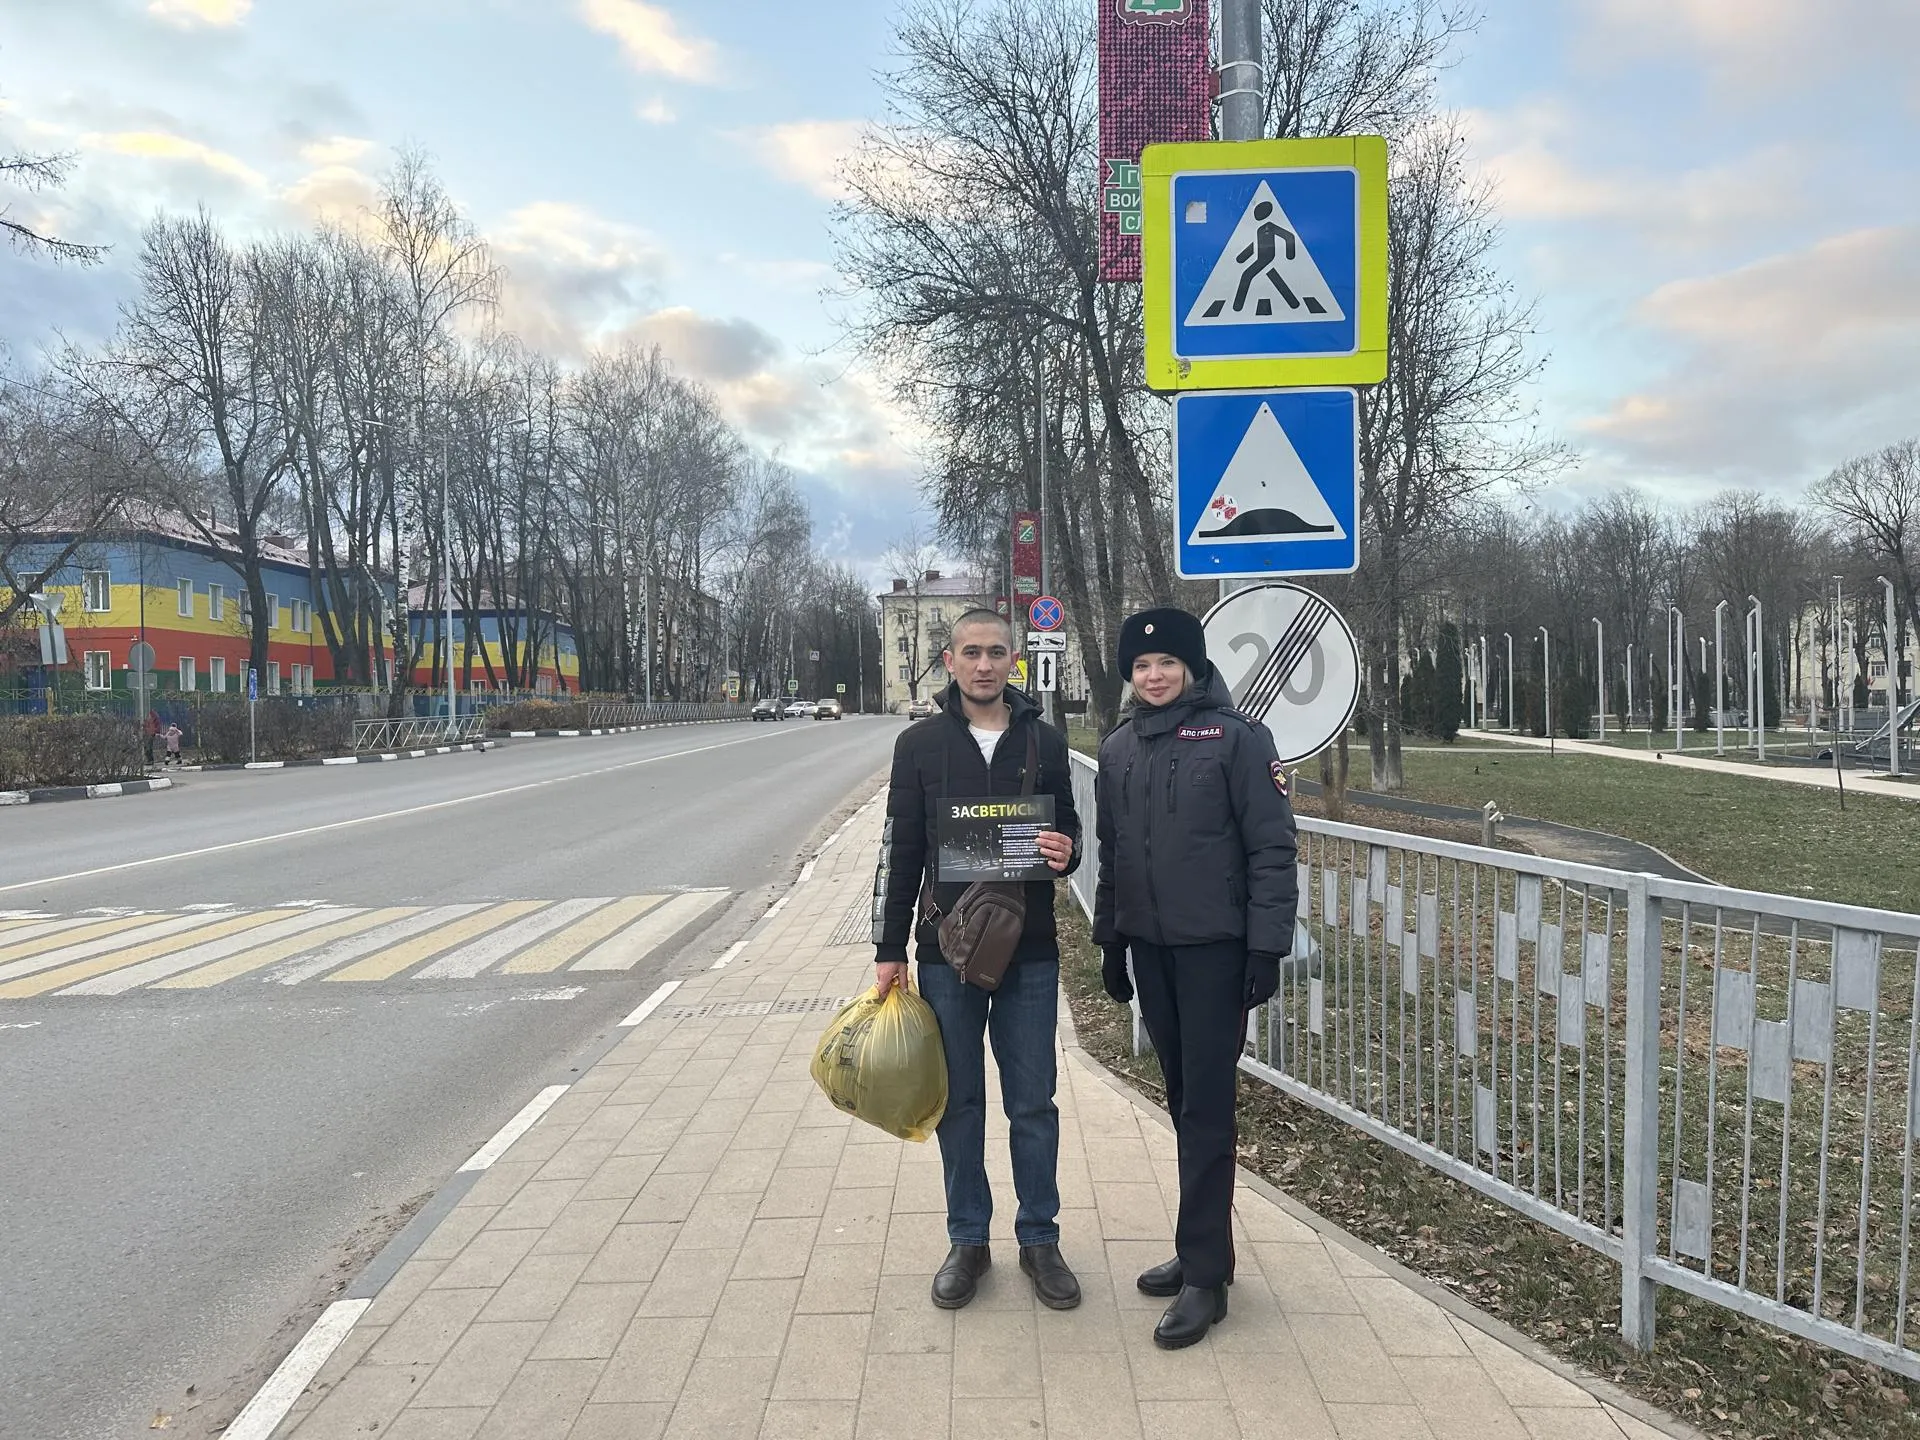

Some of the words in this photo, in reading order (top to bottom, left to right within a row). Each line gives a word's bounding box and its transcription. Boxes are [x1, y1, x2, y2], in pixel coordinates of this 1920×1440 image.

[1227, 630, 1325, 706] 20
[1180, 729, 1196, 737] ДПС
[1197, 728, 1220, 737] ГИБДД
